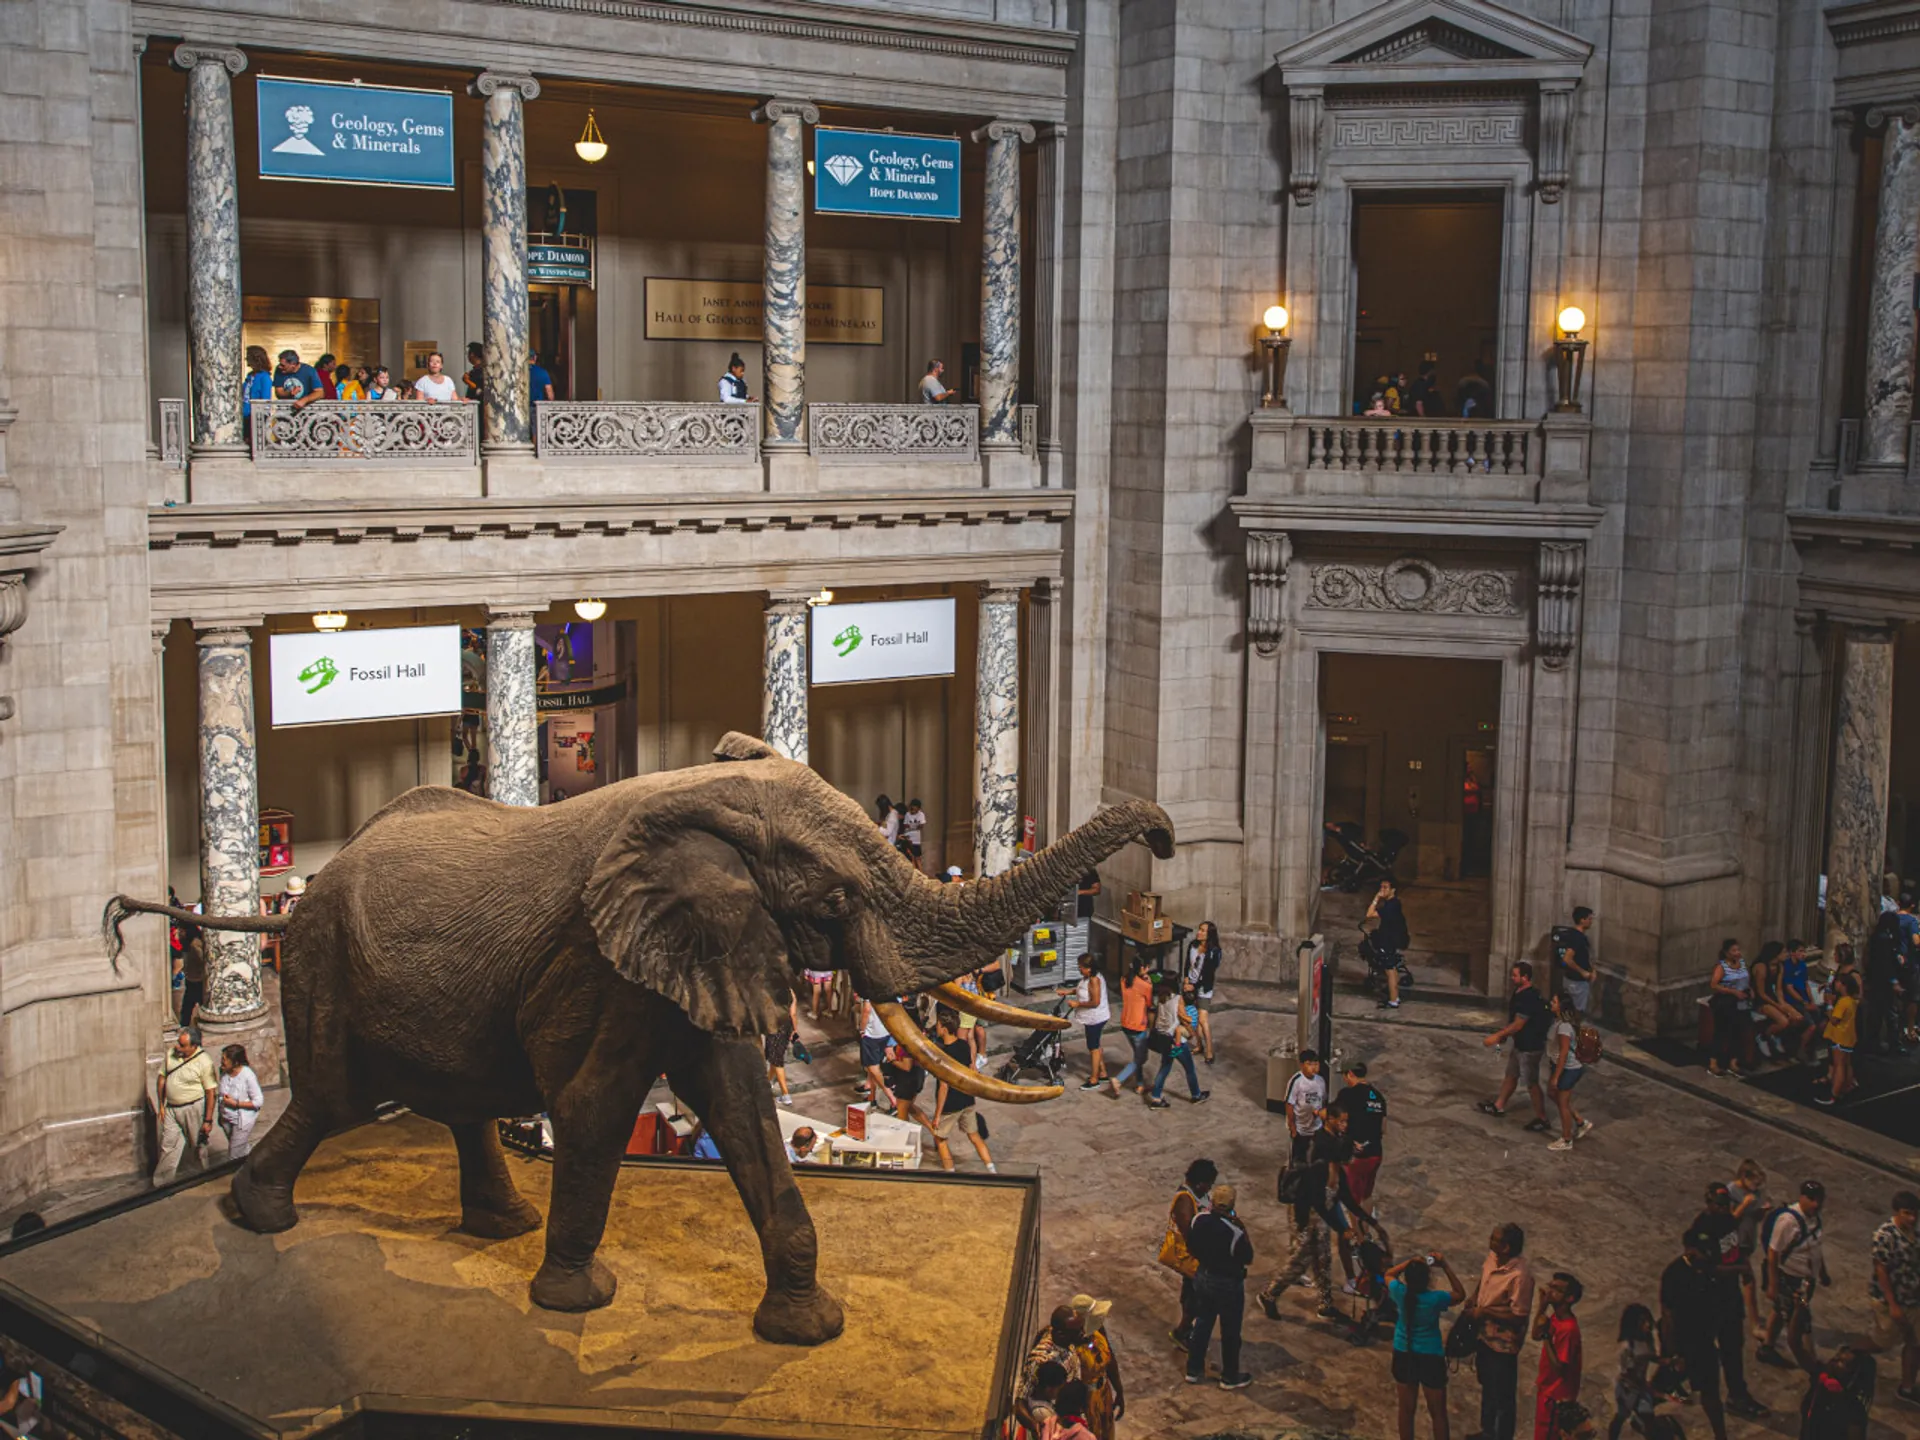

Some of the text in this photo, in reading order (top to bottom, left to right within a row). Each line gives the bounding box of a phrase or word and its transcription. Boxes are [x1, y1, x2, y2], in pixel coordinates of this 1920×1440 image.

[331, 113, 444, 137] Geology, Gems
[332, 133, 421, 154] & Minerals
[869, 149, 954, 170] Geology, Gems
[869, 167, 936, 184] & Minerals
[703, 297, 730, 308] JANET
[655, 311, 684, 323] HALL
[688, 315, 702, 324] OF
[824, 317, 876, 329] MINERALS
[871, 631, 929, 646] Fossil Hall
[350, 663, 426, 681] Fossil Hall
[568, 694, 592, 706] HALL
